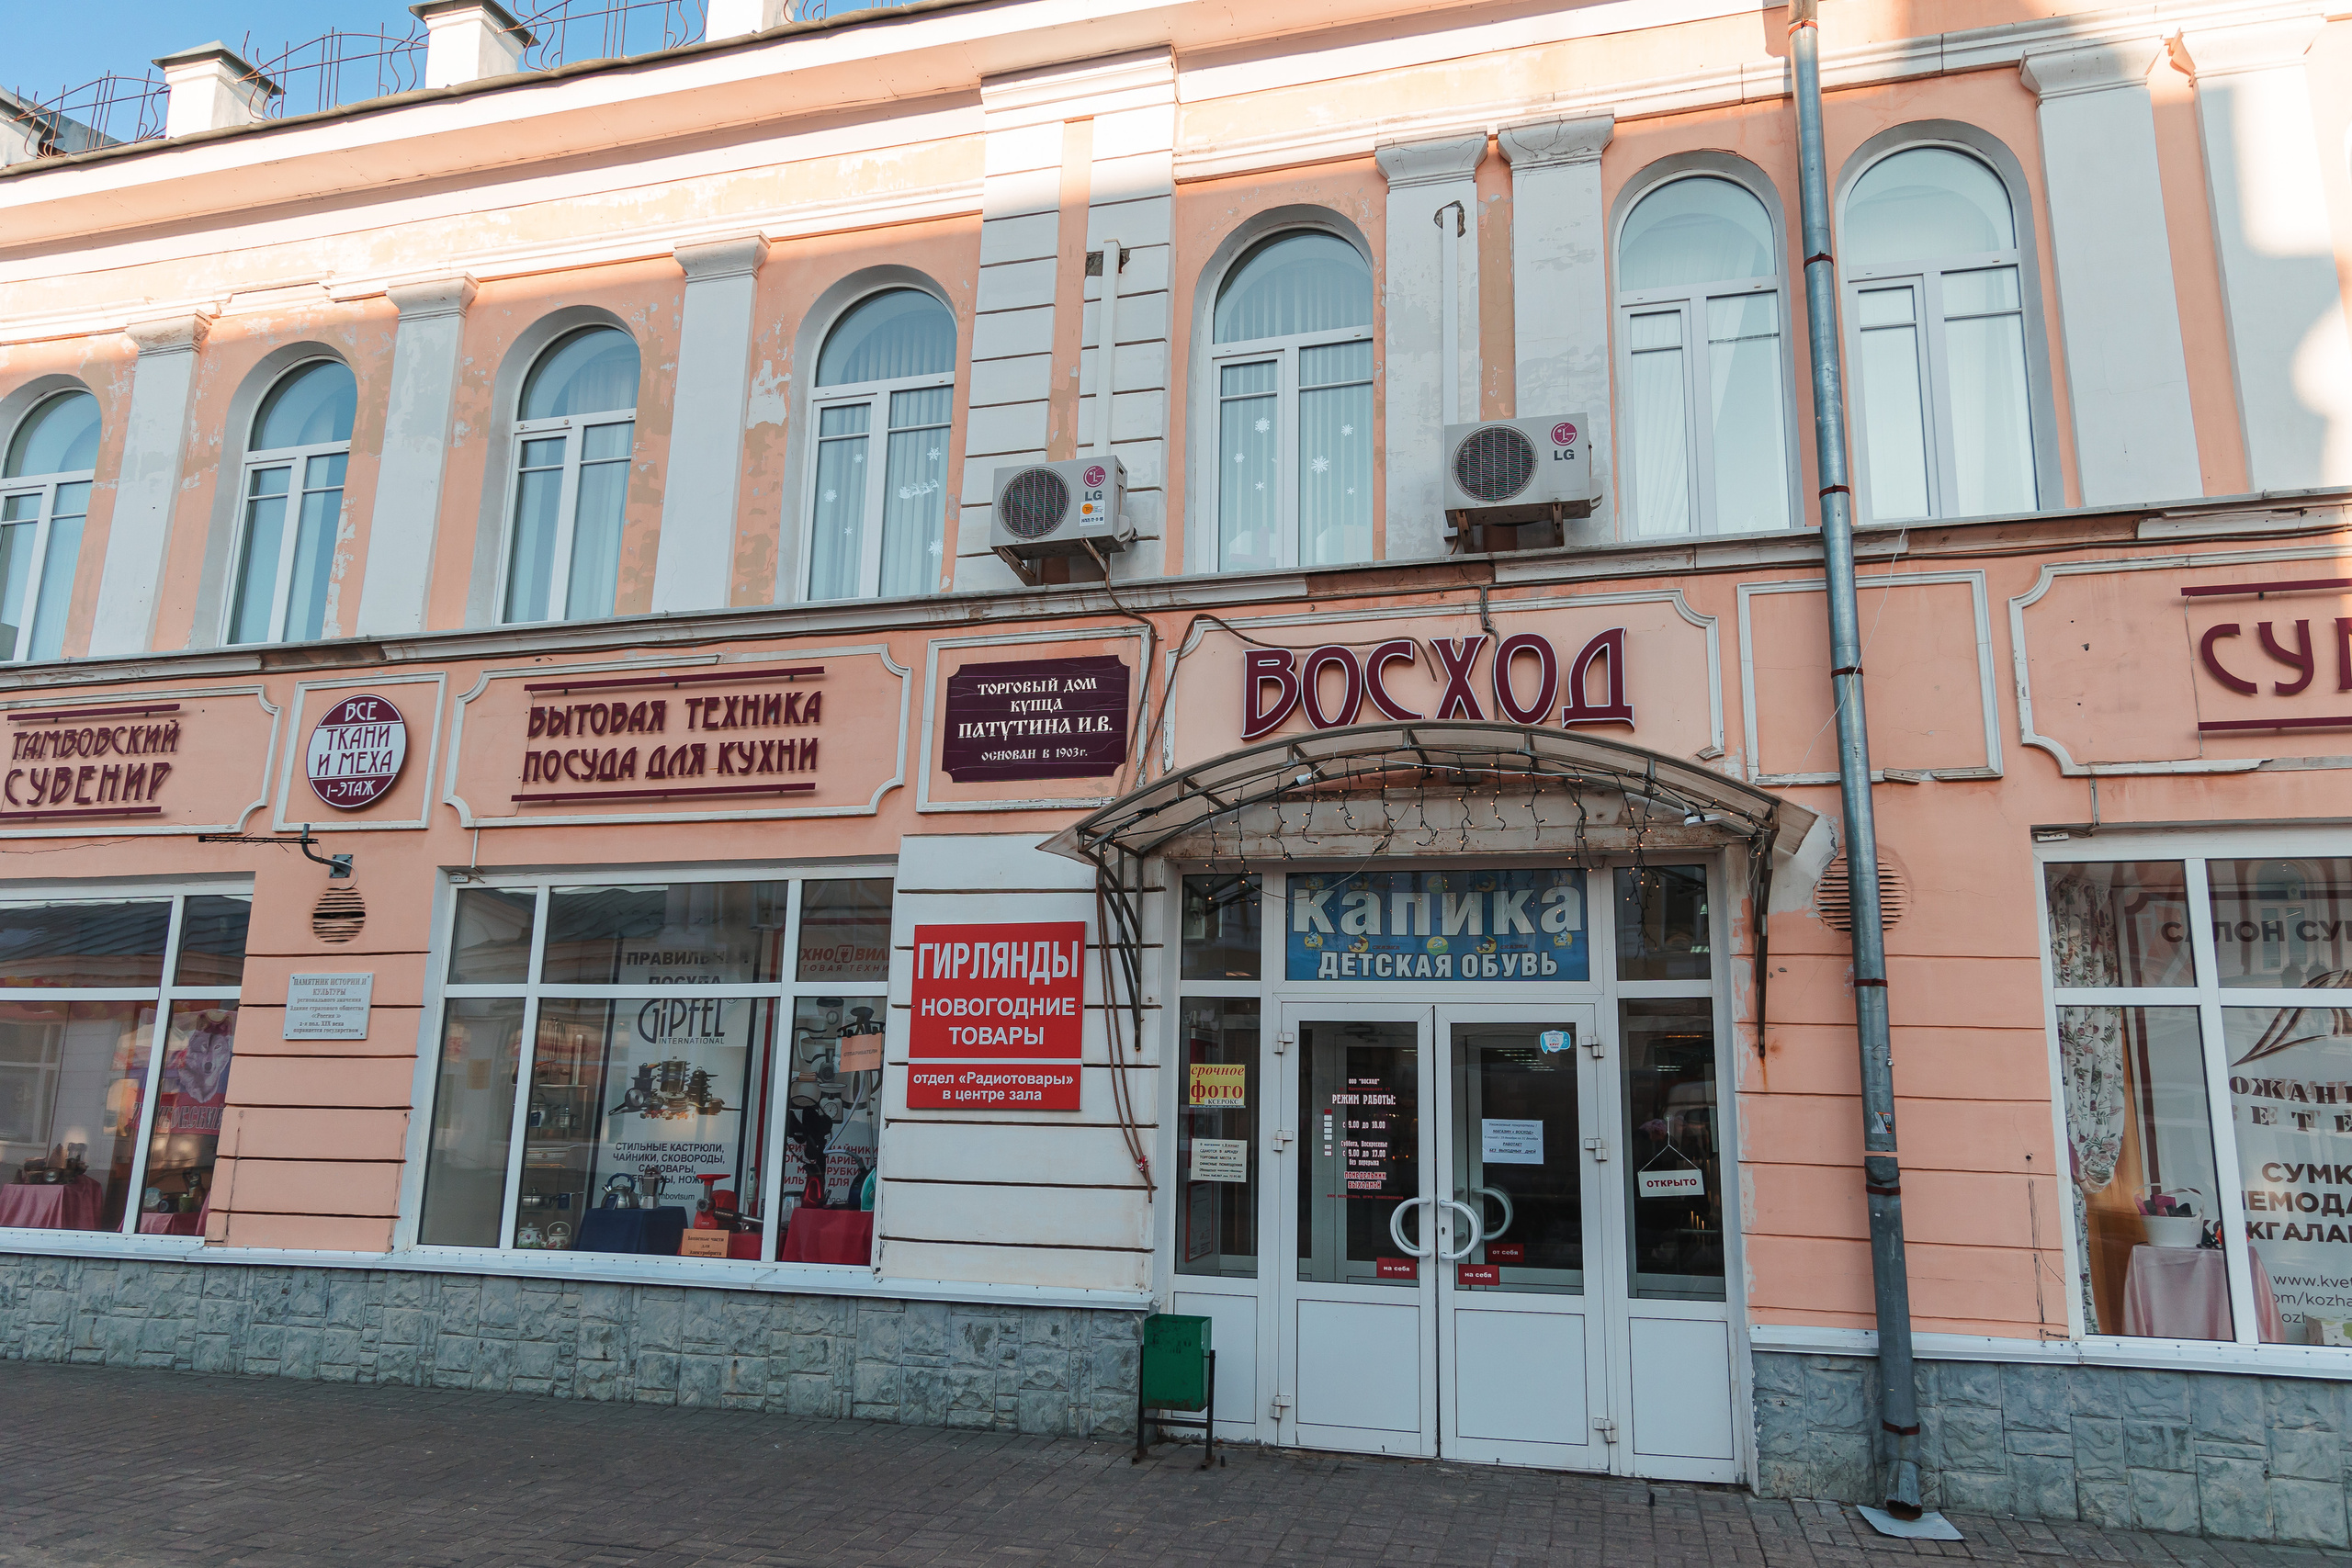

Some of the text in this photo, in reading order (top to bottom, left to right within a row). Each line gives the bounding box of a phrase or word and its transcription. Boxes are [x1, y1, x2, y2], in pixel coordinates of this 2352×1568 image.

[1554, 449, 1575, 460] LG
[1085, 491, 1102, 501] LG
[978, 677, 1097, 695] ТОРГОВЫЙ ДОМ
[1240, 626, 1635, 740] ВОСХОД
[345, 701, 378, 722] ВСЕ
[527, 690, 822, 737] БЫТОВАЯ ТЕХНИКА
[1010, 697, 1063, 715] КУПЦА
[957, 716, 1114, 740] ПАТУТИНА И.В.
[12, 719, 179, 761] ТАМБОВСКИЙ
[326, 726, 390, 750] ТКАНИ
[317, 750, 393, 776] И МЕХА
[522, 738, 819, 782] ПОСУДА ДЛЯ КУХНИ
[981, 749, 1036, 761] ОСНОВАН
[1042, 749, 1050, 759] В
[5, 762, 172, 806] СУВЕНИР
[326, 780, 377, 797] 1-ЭТАЖ
[2161, 919, 2286, 942] СЛОН
[918, 941, 1079, 986] ГИРЛЯНДЫ
[1318, 952, 1558, 980] ДЕТСКАЯ ОБУВЬ
[921, 997, 1076, 1020] НОВОГОДНИЕ
[948, 1026, 1044, 1045] ТОВАРЫ
[913, 1071, 1074, 1088] отдел «Радиотовары»
[1191, 1066, 1245, 1077] срочное
[943, 1090, 1042, 1102] в центре зала
[1190, 1079, 1243, 1102] фото
[1332, 1094, 1396, 1105] РЕЖИМ РАБОТЫ:
[1348, 1121, 1359, 1129] 9.00
[616, 1142, 724, 1153] СТИЛЬНЫЕ КАСТРЮЛИ,
[1348, 1149, 1359, 1157] 9.00
[613, 1151, 725, 1164] ЧАЙНИКИ, СКОВОРОДЫ,
[828, 1178, 850, 1187] ДЛЯ
[1646, 1179, 1697, 1188] ОТКРЫТО
